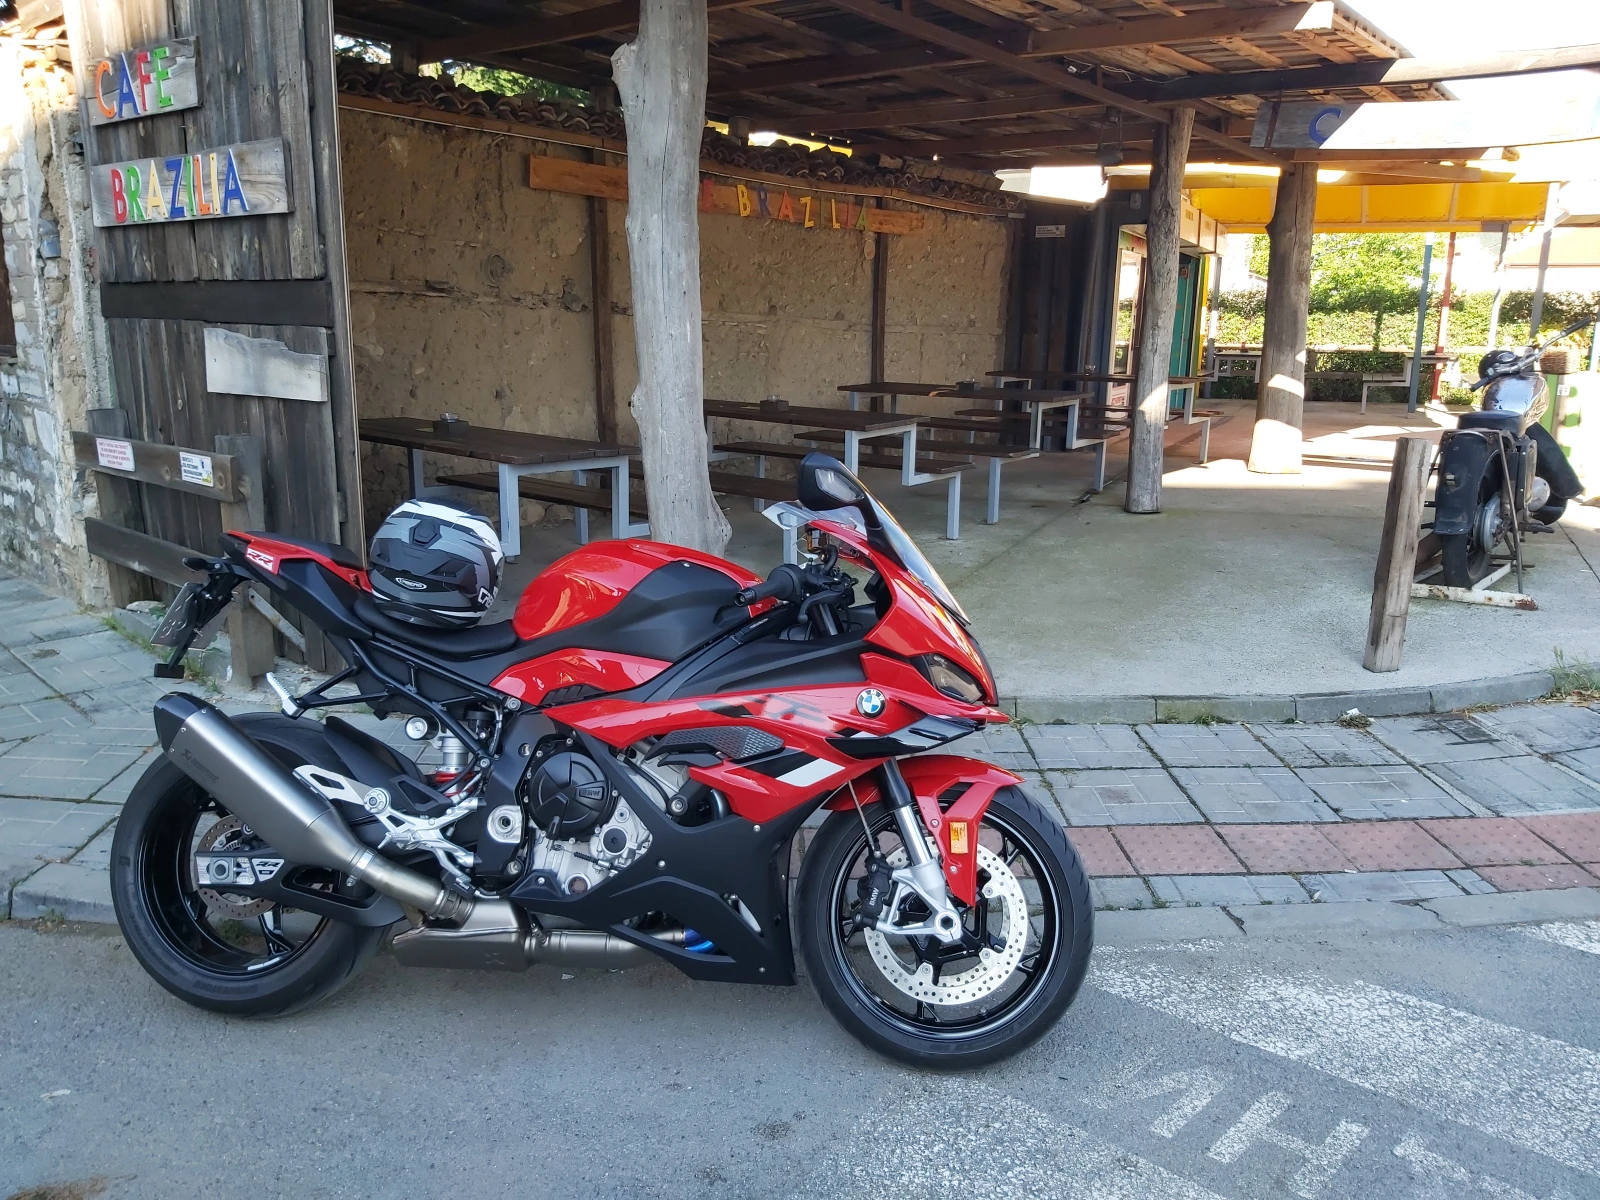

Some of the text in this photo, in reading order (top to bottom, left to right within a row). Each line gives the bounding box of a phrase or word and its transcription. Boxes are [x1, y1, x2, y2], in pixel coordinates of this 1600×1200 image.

[95, 47, 174, 119] CAFE
[111, 148, 249, 224] BRAZILIA
[737, 184, 868, 230] BRAZILIA
[868, 887, 880, 906] BMW
